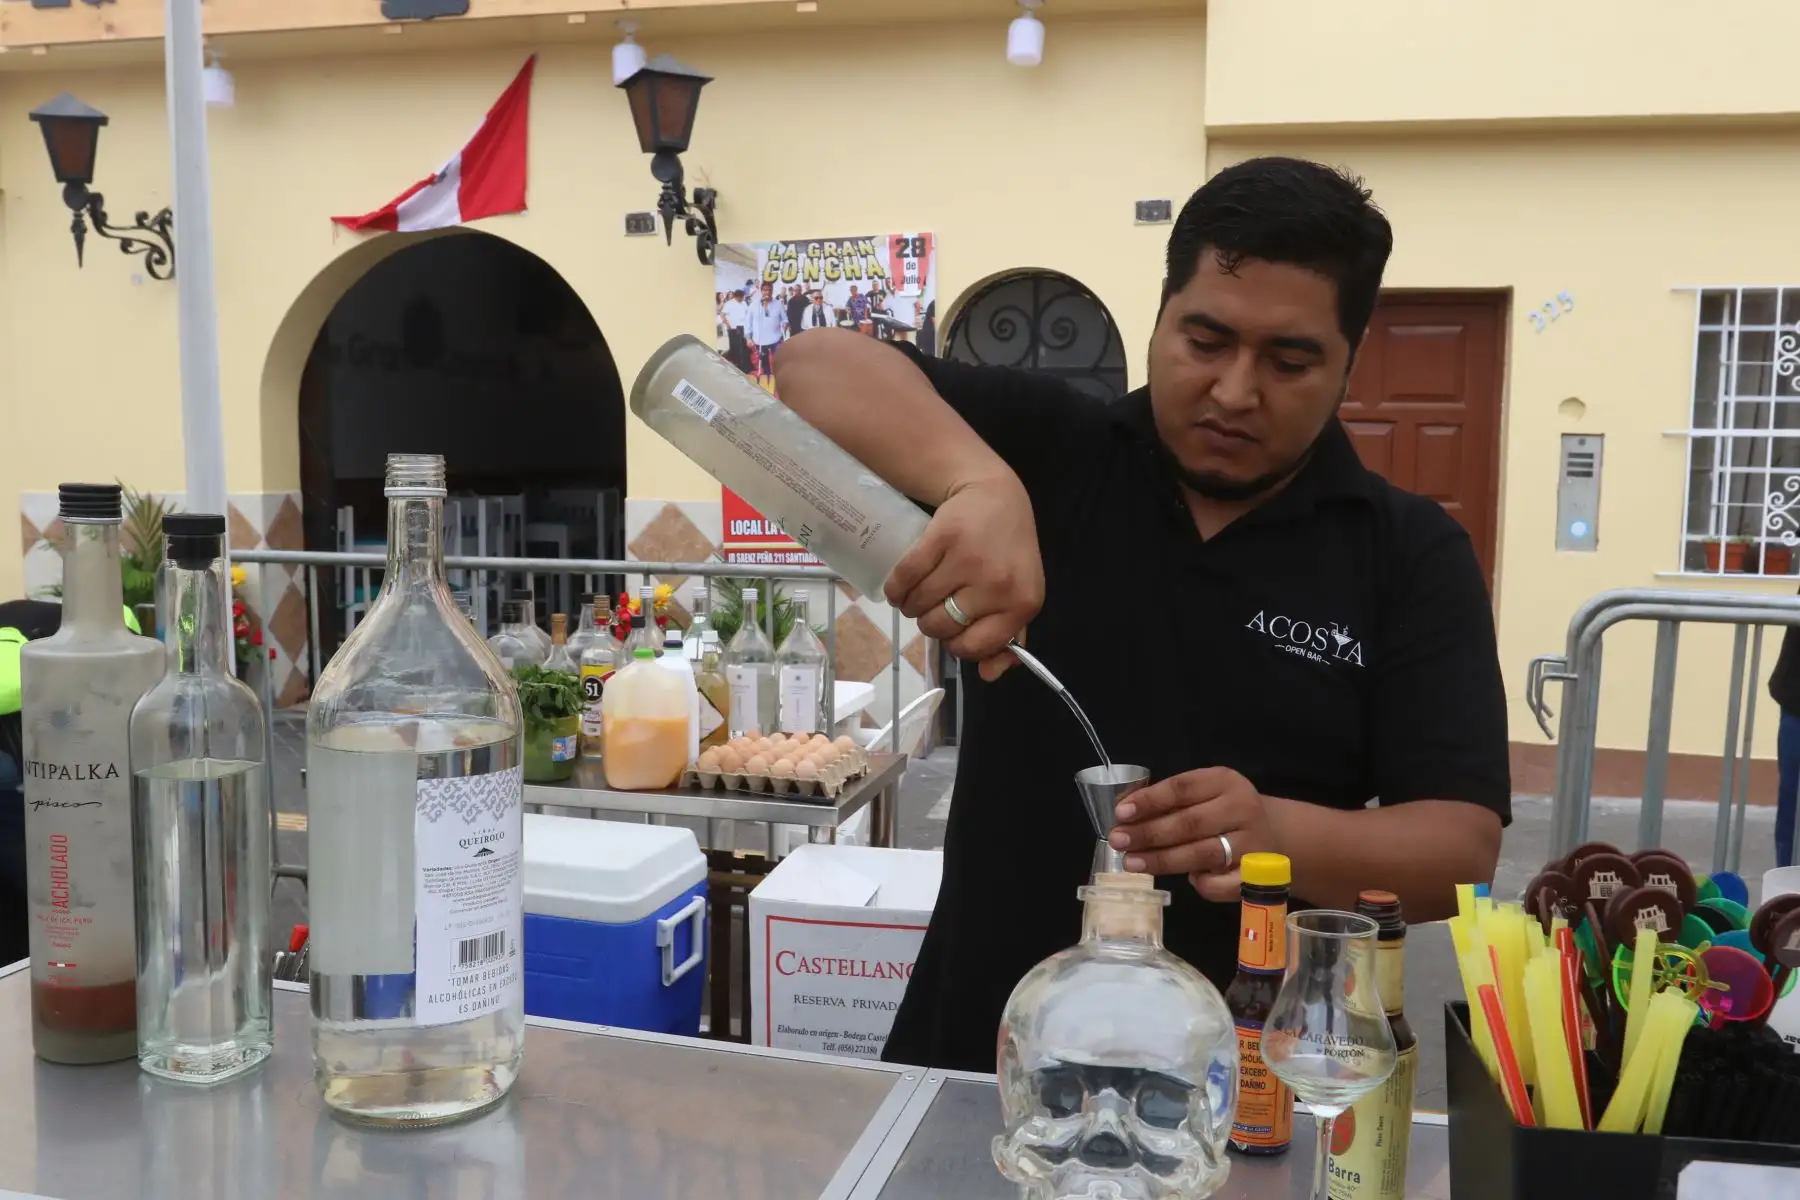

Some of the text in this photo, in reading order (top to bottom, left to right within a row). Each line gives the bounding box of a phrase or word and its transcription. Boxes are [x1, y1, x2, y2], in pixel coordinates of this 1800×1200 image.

[768, 239, 876, 260] LA GRAN
[895, 237, 927, 259] 28
[763, 254, 886, 284] CONCHA
[905, 260, 917, 271] de
[1527, 288, 1574, 334] 225
[730, 519, 763, 536] LOCAL
[736, 552, 756, 564] SAENZ
[1245, 610, 1366, 668] ACOSTA
[1285, 644, 1323, 663] OPEN BAR
[585, 682, 600, 698] 51
[458, 830, 506, 850] QUEIROLO
[50, 833, 70, 913] ACHOLADO
[488, 982, 497, 992] EN
[458, 1003, 468, 1014] ES
[793, 993, 899, 1012] RESERVA PRIVAD
[777, 1024, 809, 1036] Elaborado
[809, 1028, 818, 1037] en
[818, 1027, 839, 1039] origen
[843, 1030, 866, 1042] Bodega
[1328, 1156, 1361, 1184] Barra
